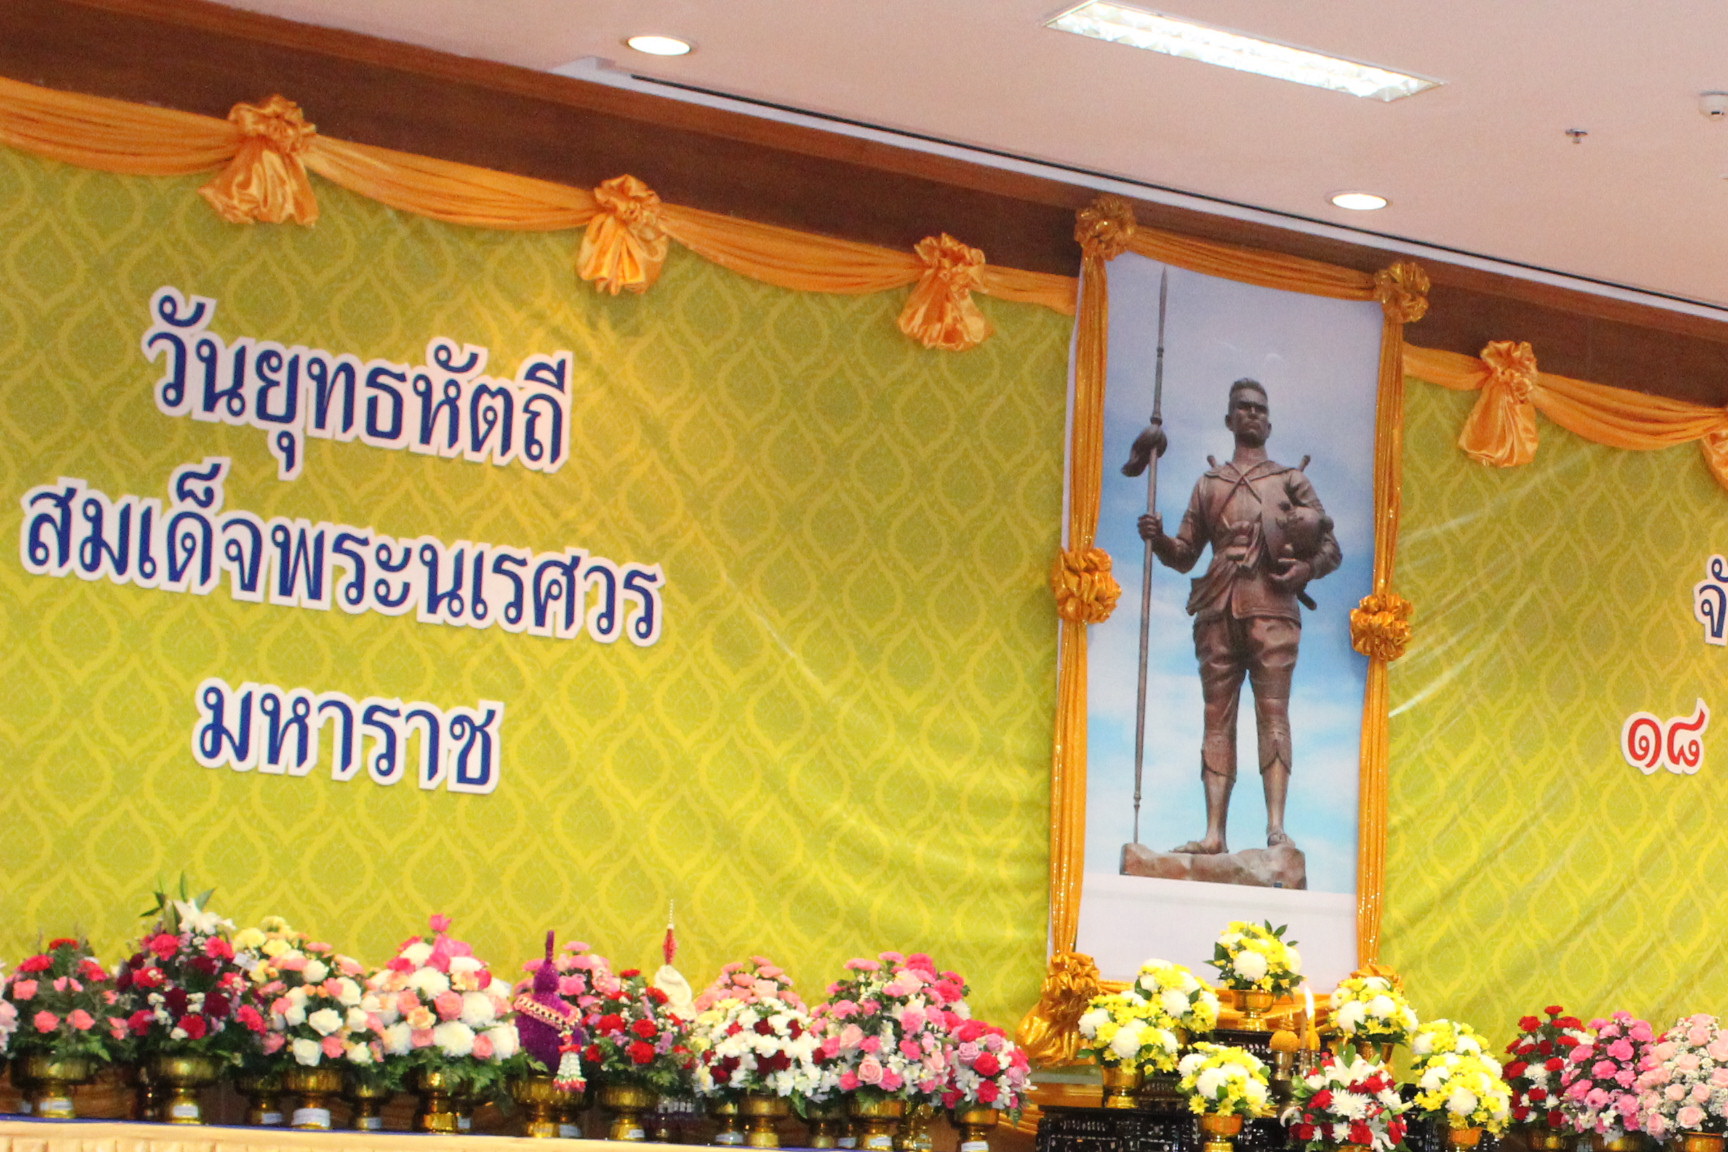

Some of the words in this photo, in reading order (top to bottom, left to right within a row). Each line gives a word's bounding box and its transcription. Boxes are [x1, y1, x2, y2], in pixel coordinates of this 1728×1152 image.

[145, 293, 567, 472] วันยุทธหัตถี
[26, 461, 659, 640] สมเด็จพระนเรศวร
[197, 685, 497, 787] มหาราช
[1627, 709, 1707, 769] ๑๘
